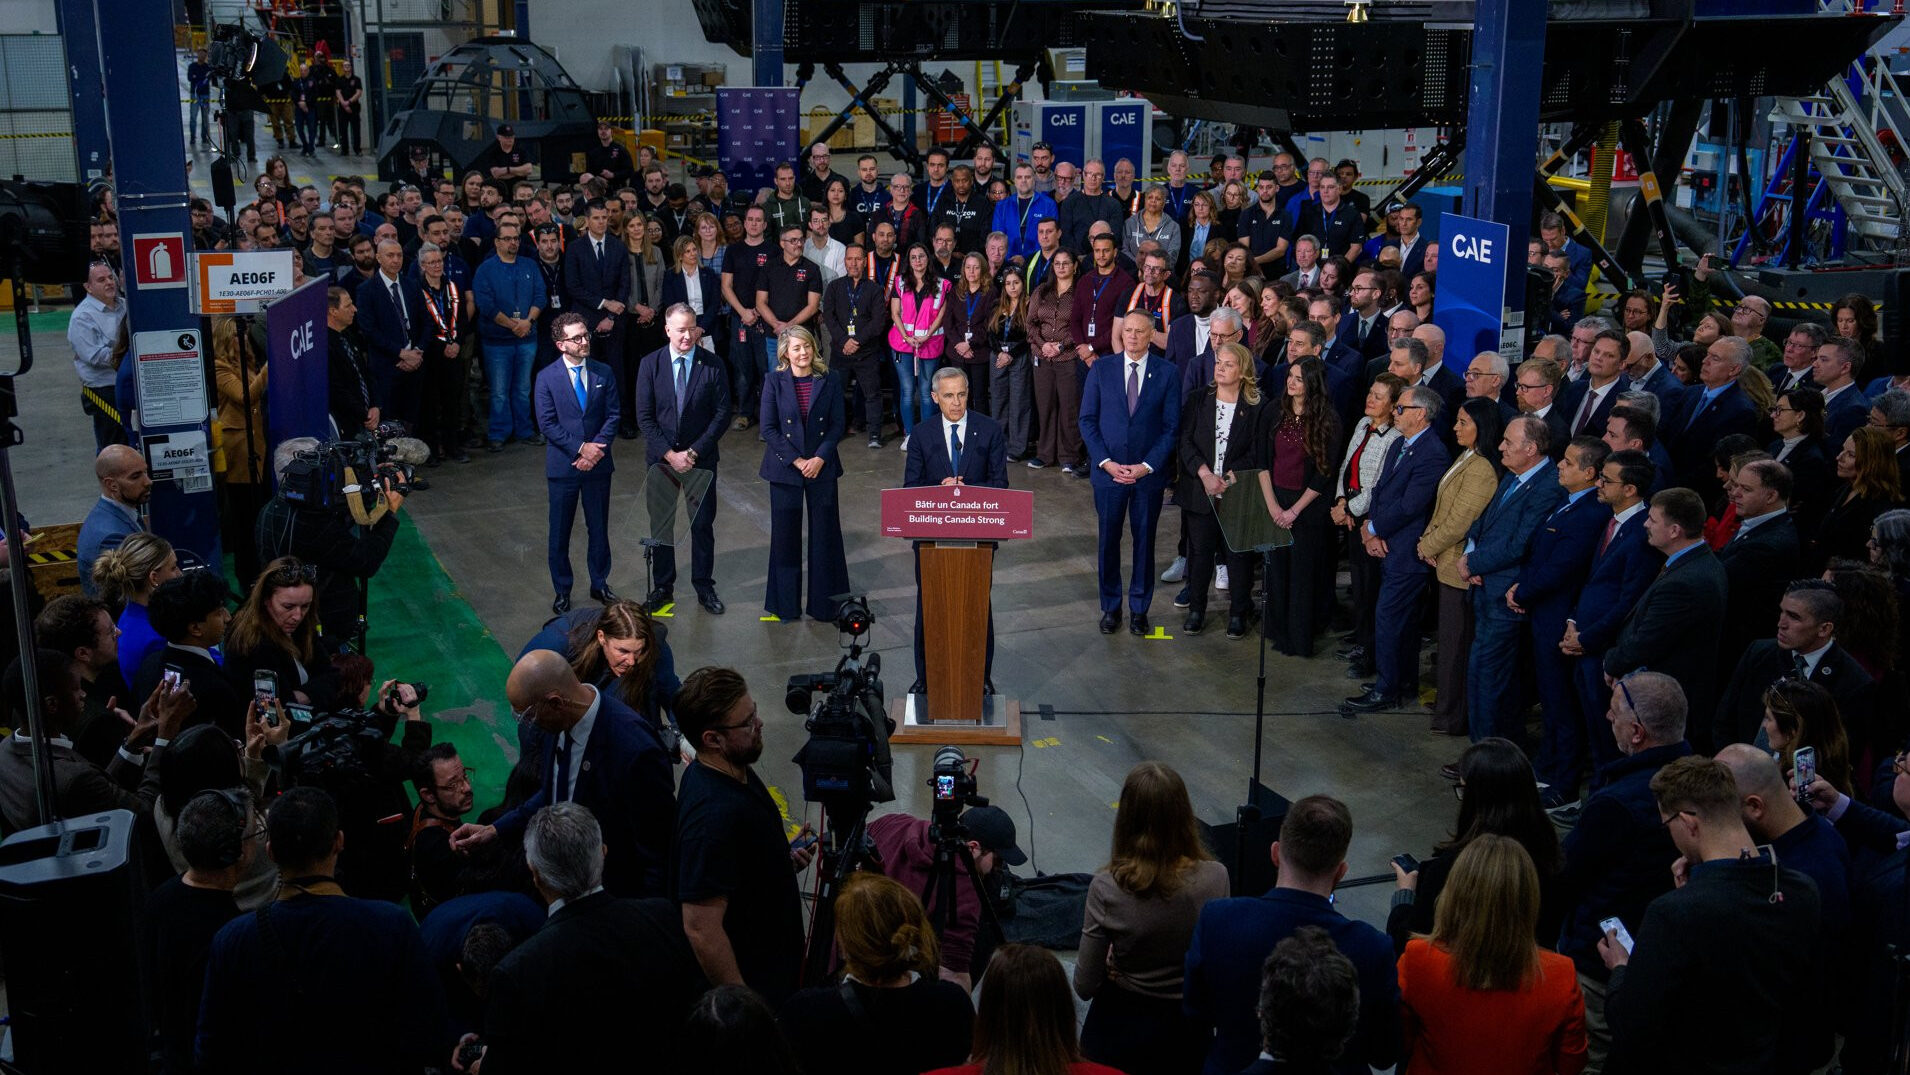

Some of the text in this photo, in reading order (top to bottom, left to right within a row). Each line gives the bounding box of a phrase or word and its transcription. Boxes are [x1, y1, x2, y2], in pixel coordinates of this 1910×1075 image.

[1050, 114, 1076, 126] CAE
[1110, 113, 1136, 124] CAE
[1452, 234, 1492, 264] CAE
[230, 272, 276, 284] AE06F
[291, 320, 314, 360] CAE
[164, 448, 194, 458] AE06F
[916, 500, 936, 508] Bâtir
[950, 500, 980, 509] Canada
[982, 501, 998, 510] fort
[909, 515, 1004, 525] Building Canada Strong
